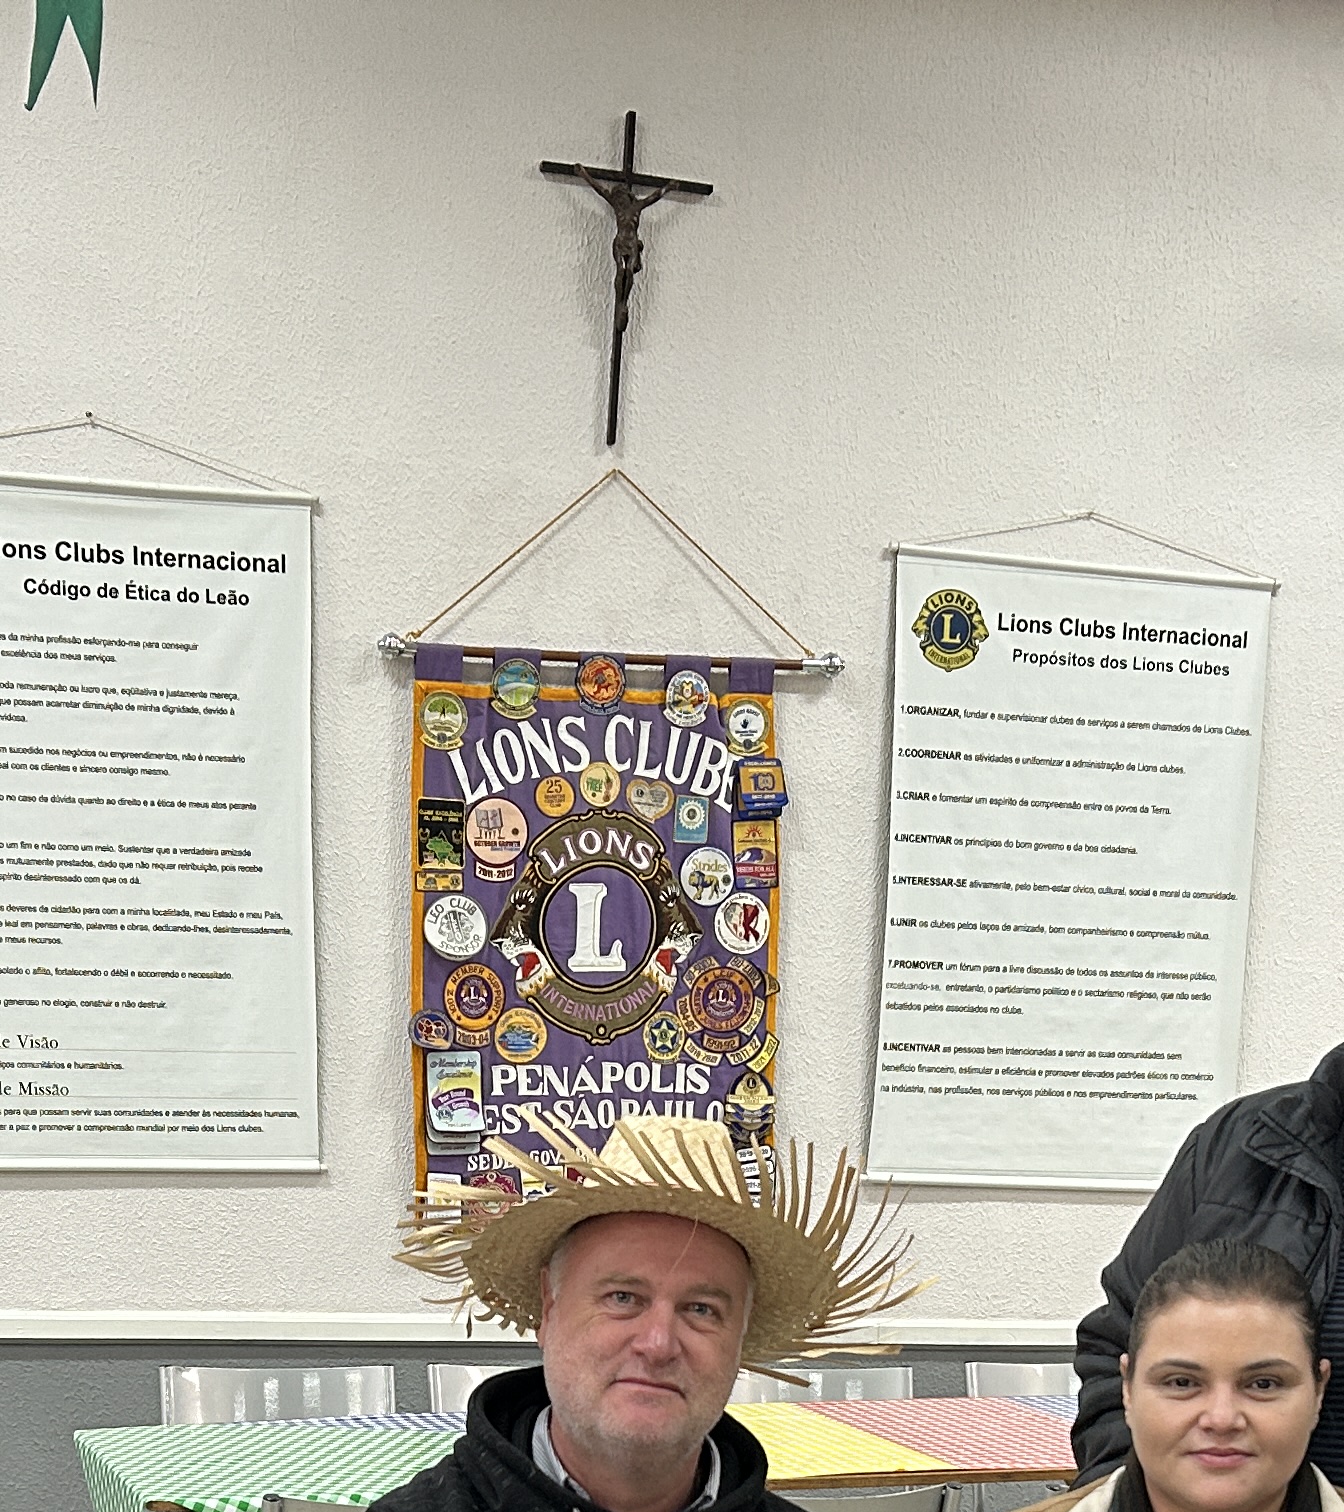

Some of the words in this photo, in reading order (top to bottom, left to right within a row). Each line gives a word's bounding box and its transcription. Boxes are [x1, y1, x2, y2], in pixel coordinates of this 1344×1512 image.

[55, 541, 124, 565] Clubs
[133, 545, 286, 574] Internacional
[24, 578, 90, 600] Código
[97, 583, 119, 599] de
[126, 580, 171, 602] Ética
[177, 586, 199, 603] do
[206, 589, 250, 606] Leão
[930, 593, 974, 611] LIONS
[941, 614, 961, 644] L
[998, 613, 1052, 634] Lions
[1060, 617, 1115, 639] Clubs
[1123, 622, 1248, 648] Internacional
[1013, 648, 1095, 667] Propósitos
[1100, 655, 1127, 669] dos
[1133, 656, 1173, 673] Lions
[1179, 659, 1230, 676] Clubes
[447, 716, 590, 805] LIONS
[546, 780, 562, 794] 25
[539, 829, 654, 875] LIONS
[692, 859, 728, 872] Strides
[427, 904, 444, 925] LEO
[449, 897, 478, 915] CLUB
[567, 882, 627, 973] L
[439, 934, 483, 954] SPONSOR
[539, 981, 657, 1021] INTERNATIONAL
[17, 1034, 59, 1049] Visão
[19, 1081, 70, 1096] Missão
[490, 1055, 711, 1097] PENÁPOLIS
